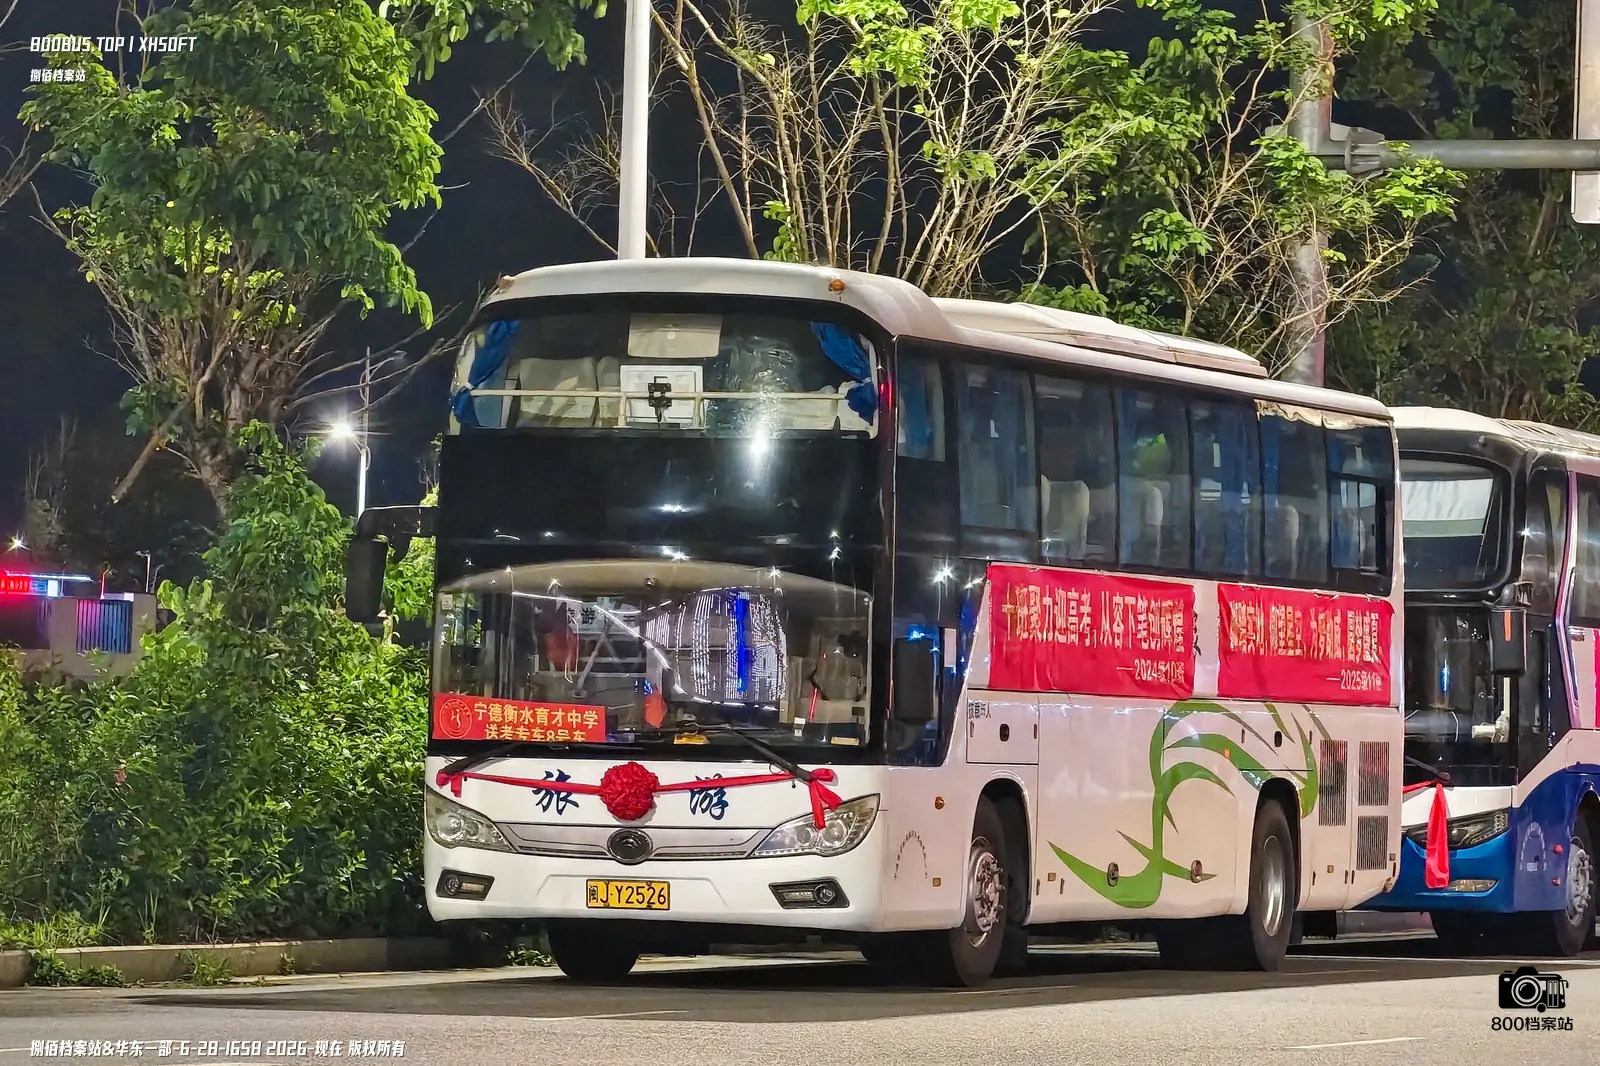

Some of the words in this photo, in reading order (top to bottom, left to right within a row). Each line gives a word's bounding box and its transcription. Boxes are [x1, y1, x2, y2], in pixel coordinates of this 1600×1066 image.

[473, 702, 599, 729] 宁德衡水育才中学
